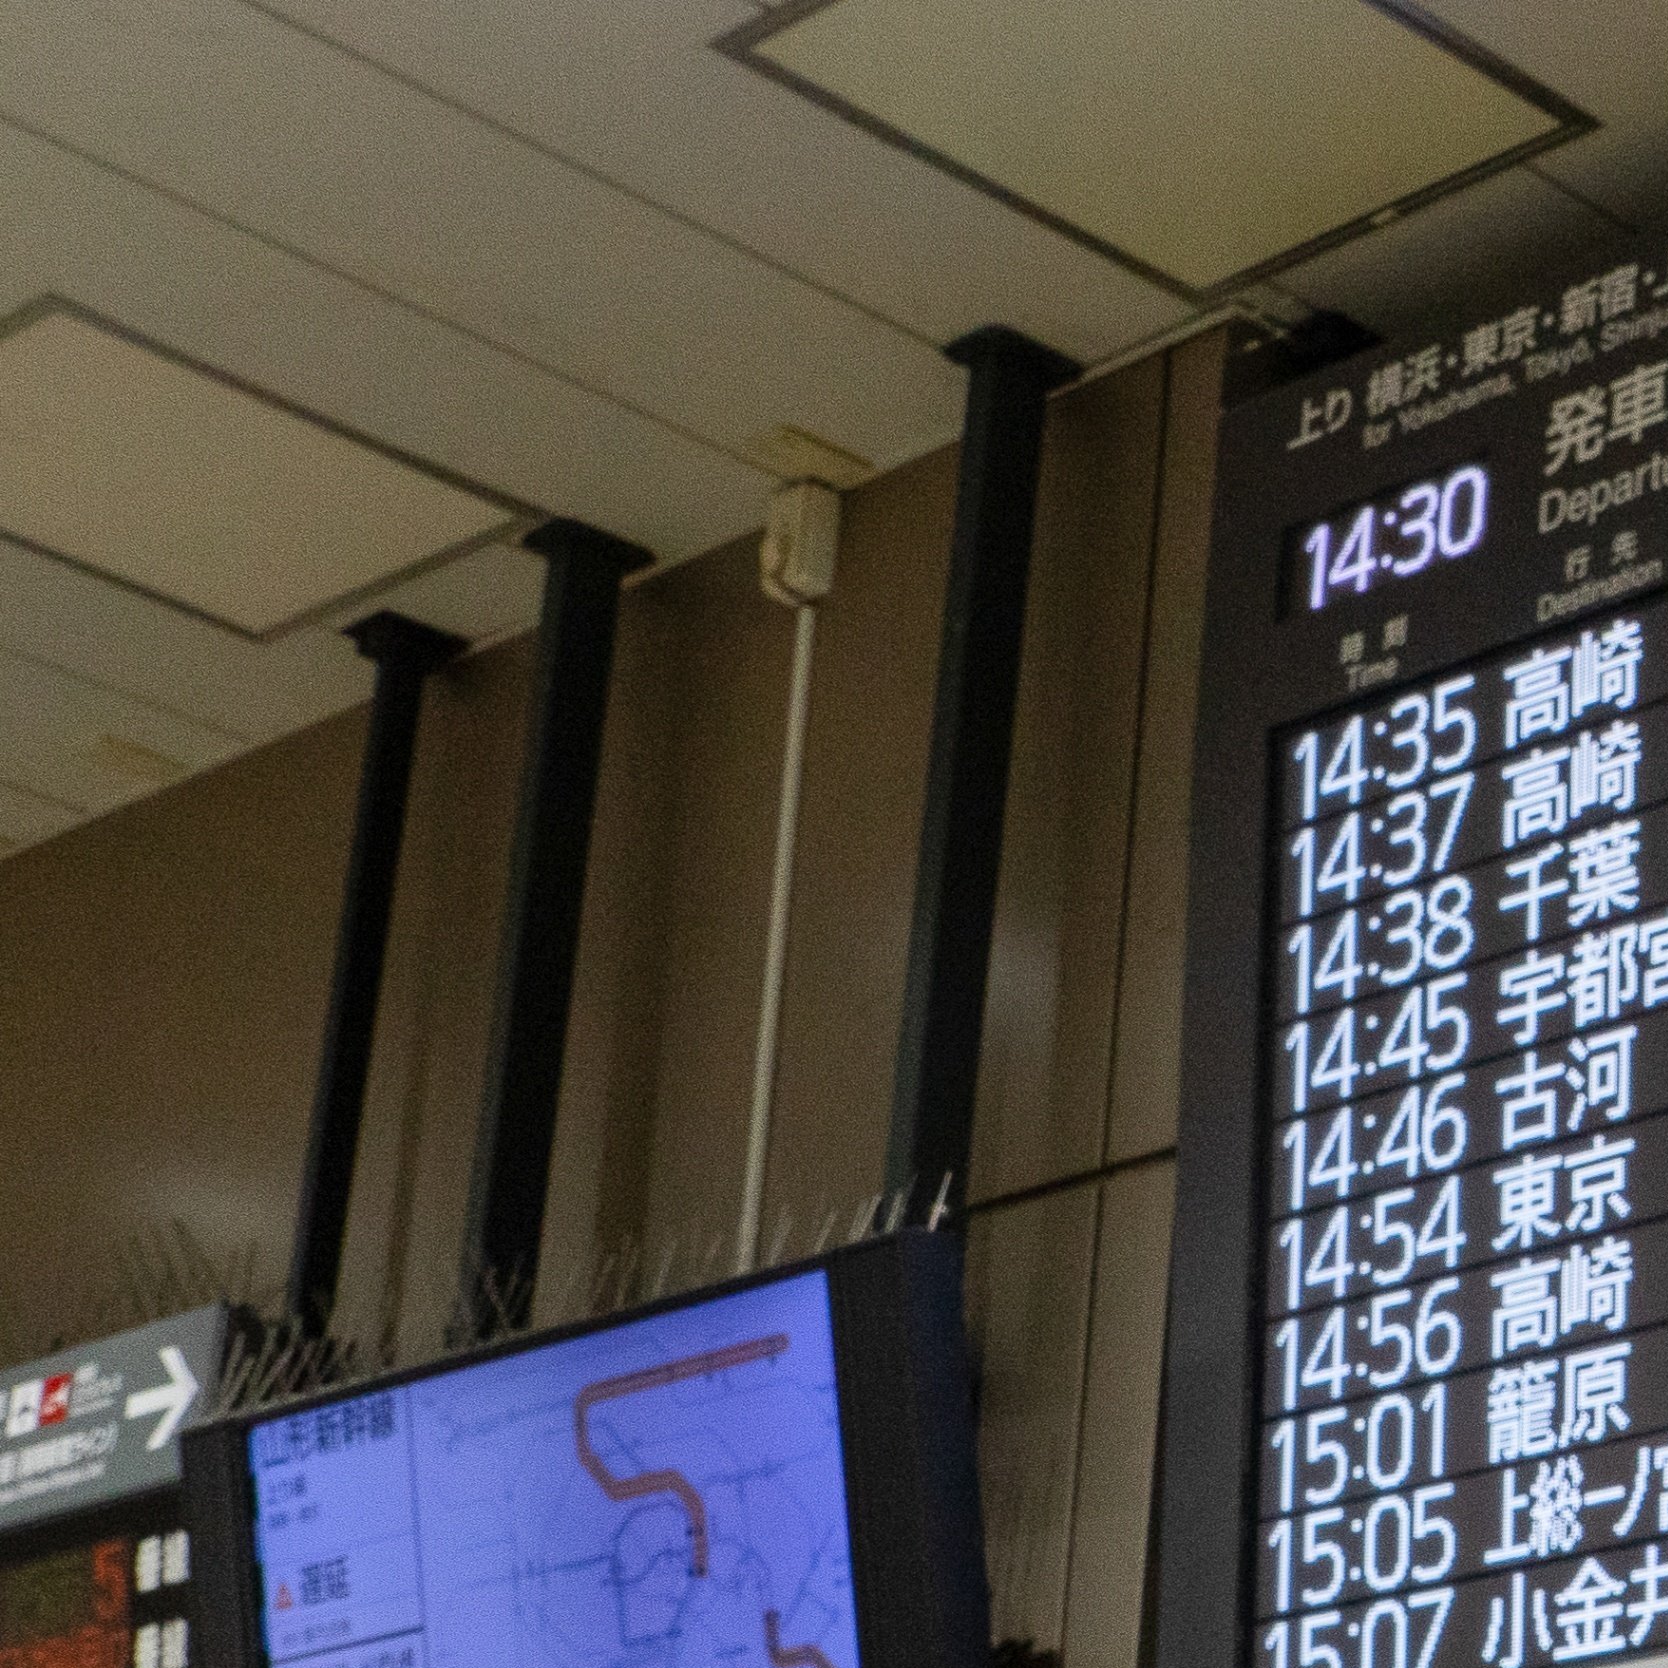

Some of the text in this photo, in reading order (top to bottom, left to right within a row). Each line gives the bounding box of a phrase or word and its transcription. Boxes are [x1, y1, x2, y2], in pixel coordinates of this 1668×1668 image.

[1286, 389, 1352, 450] 上り
[1304, 464, 1490, 611] 14:30
[1292, 674, 1479, 821] 14:35
[1502, 619, 1646, 749] 高崎
[1290, 771, 1475, 917] 14:37
[1500, 720, 1643, 849] 高崎
[1287, 873, 1474, 1014] 14:38
[1498, 819, 1642, 941] 千葉
[1282, 1073, 1469, 1212] 14:46
[1495, 1025, 1639, 1151] 古河
[1284, 973, 1471, 1113] 14:45
[1278, 1175, 1467, 1312] 14:54
[1492, 1134, 1637, 1250] 東京
[1275, 1278, 1463, 1411] 14:56
[1490, 1235, 1633, 1360] 高崎
[1270, 1382, 1449, 1513] 15:01
[1267, 1482, 1457, 1613] 15:05
